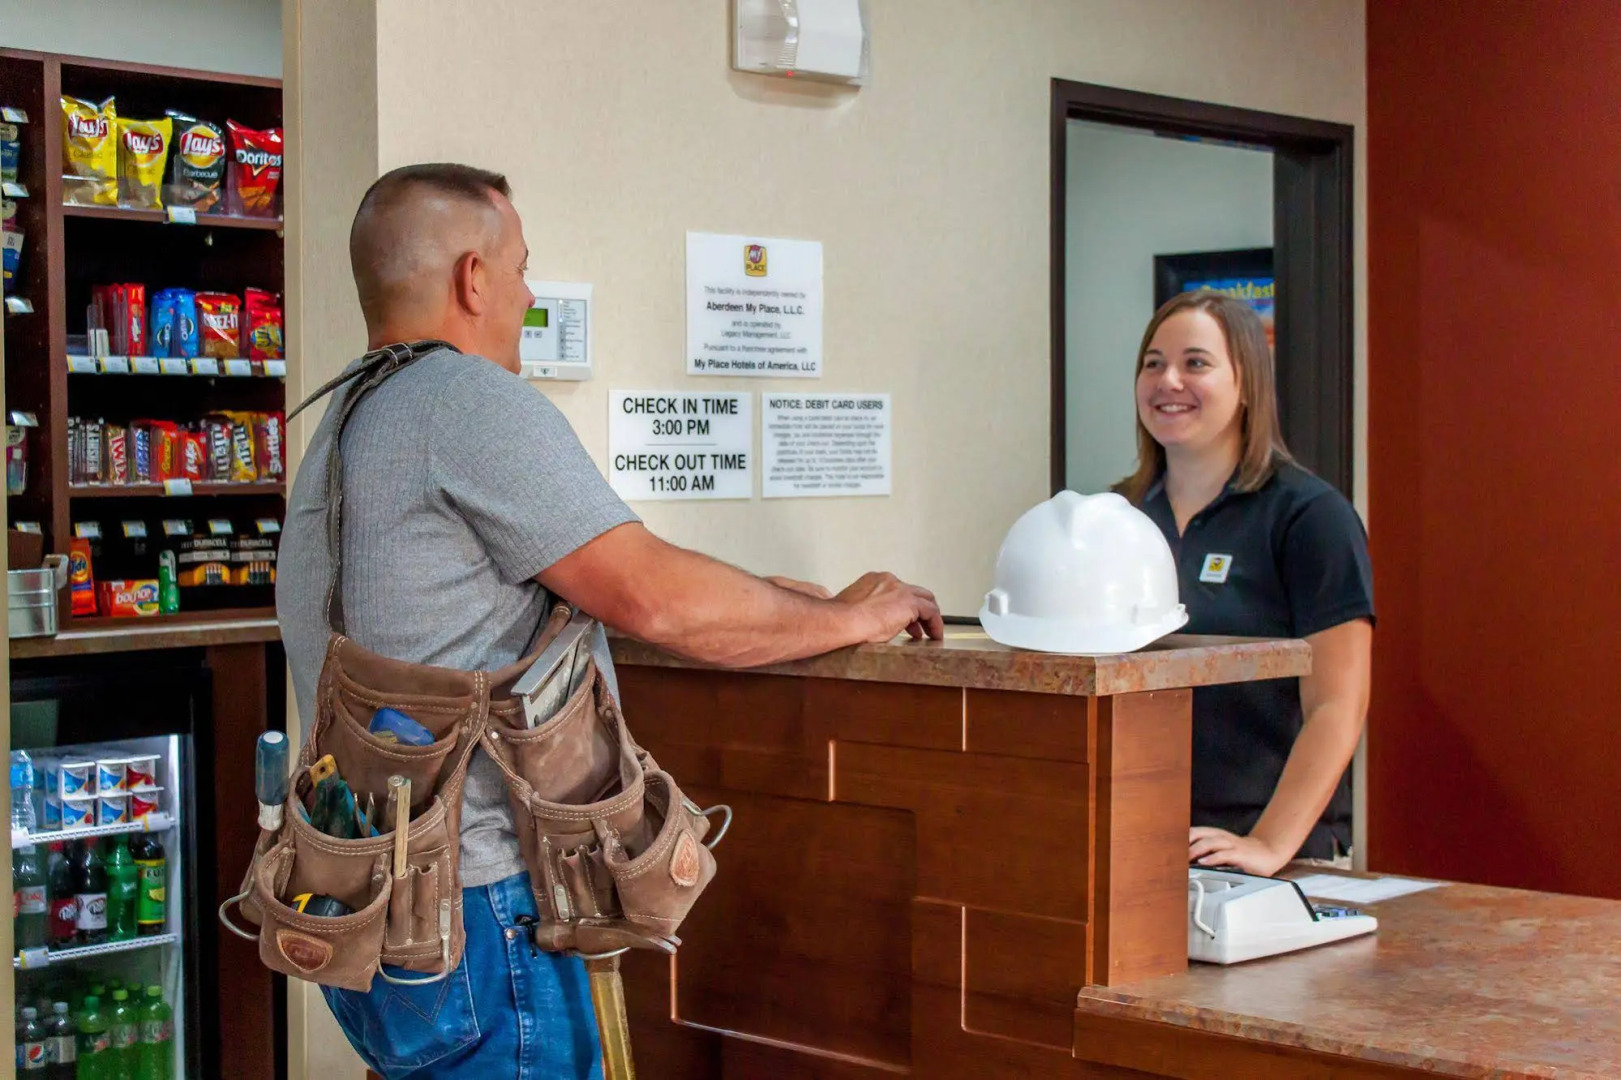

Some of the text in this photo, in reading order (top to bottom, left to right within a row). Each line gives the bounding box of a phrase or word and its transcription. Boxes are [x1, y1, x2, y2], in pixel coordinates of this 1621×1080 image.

[236, 149, 282, 166] Doritos
[706, 302, 743, 312] Aberdeen
[745, 303, 757, 315] My
[694, 359, 706, 370] My
[708, 359, 729, 369] Place
[731, 360, 756, 370] Hotels
[757, 360, 766, 370] of
[801, 362, 816, 371] LLC
[623, 397, 738, 415] CHECK IN TIME
[769, 399, 884, 410] NOTICE: DEBIT CARD USERS
[652, 419, 710, 435] 3:00 PM
[615, 454, 746, 471] CHECK OUT TIME
[650, 475, 714, 491] 11:00 AM
